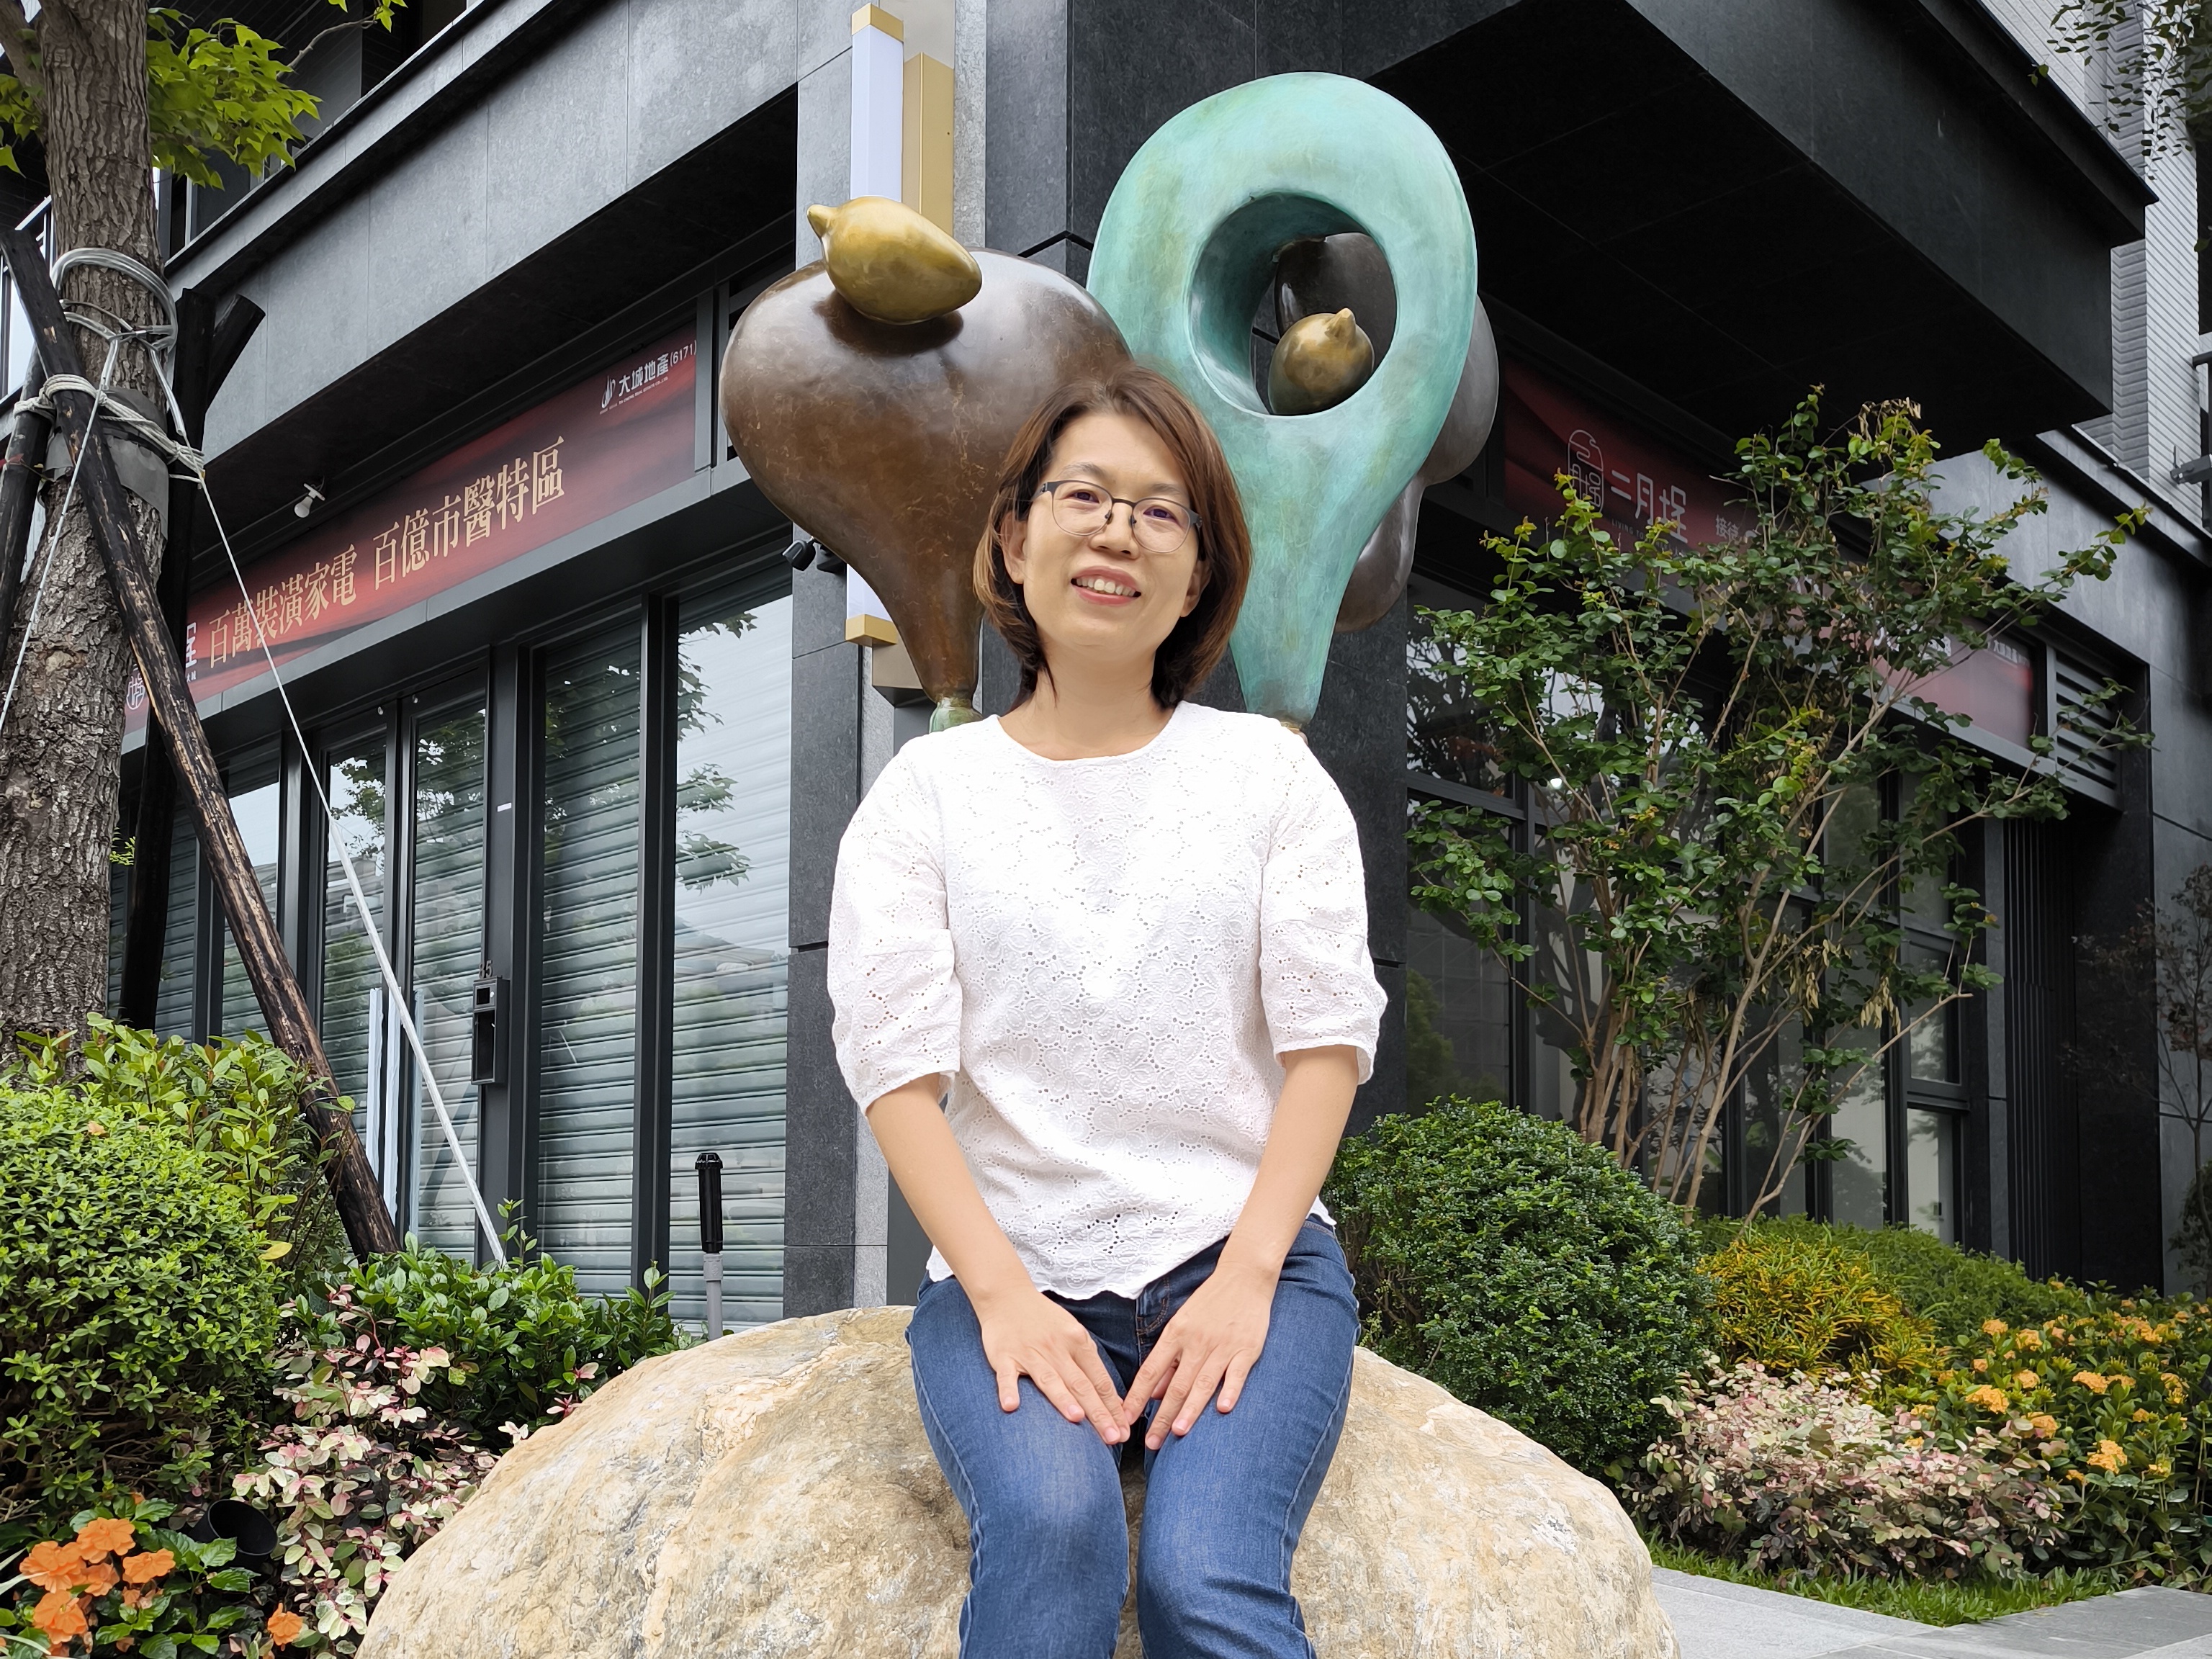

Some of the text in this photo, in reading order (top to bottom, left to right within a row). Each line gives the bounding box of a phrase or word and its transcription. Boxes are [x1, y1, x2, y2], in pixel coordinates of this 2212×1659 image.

[1611, 518, 1634, 534] LIVING
[209, 436, 565, 669] 百萬裝潢家電 百億市醫特區
[478, 959, 493, 979] 85
